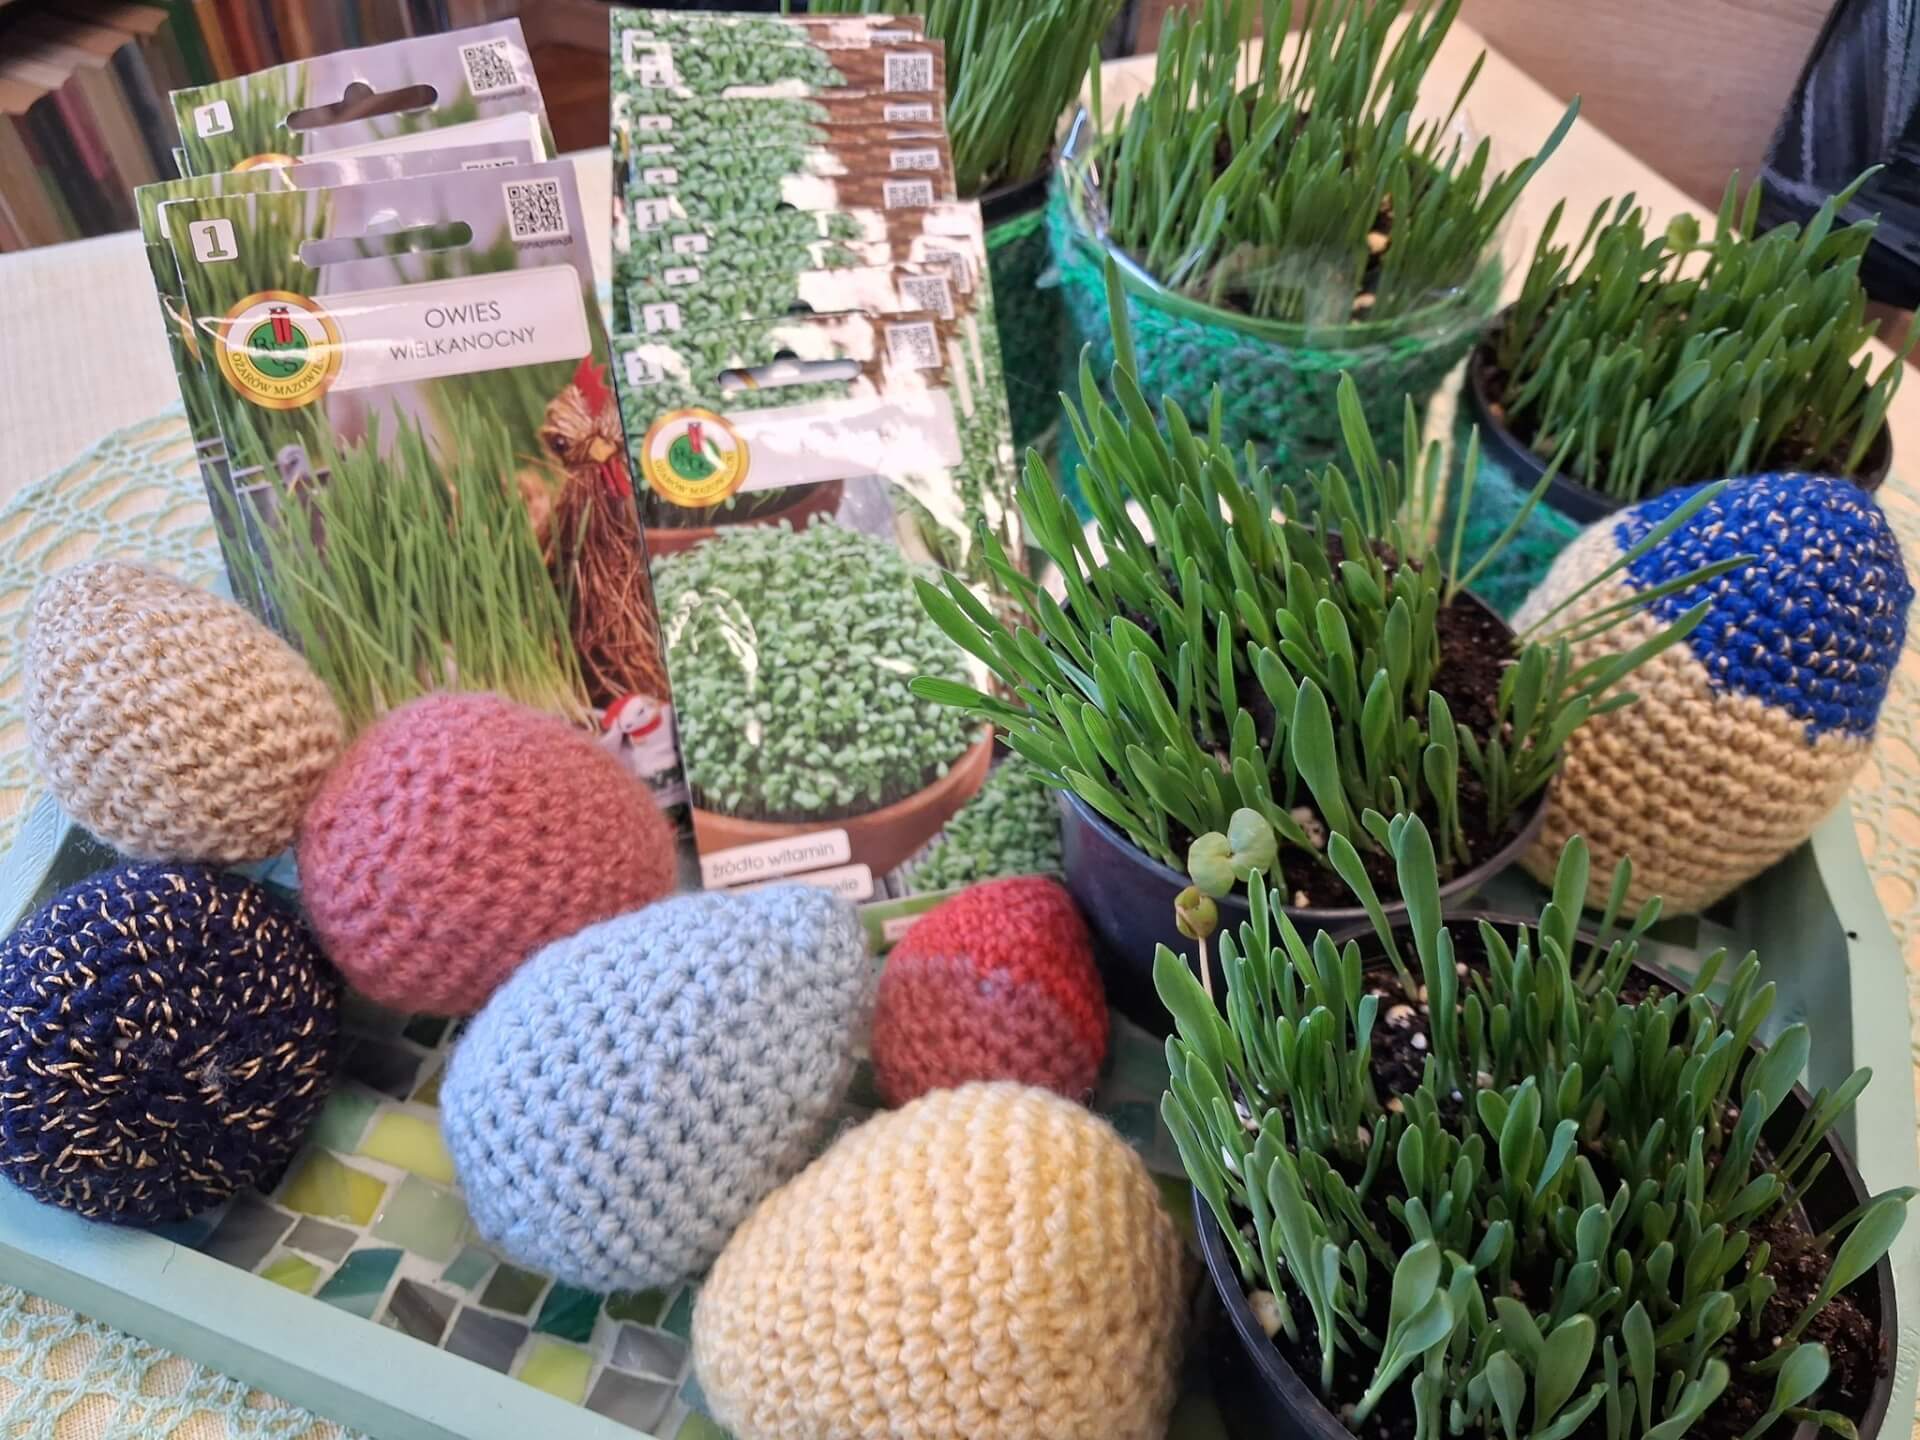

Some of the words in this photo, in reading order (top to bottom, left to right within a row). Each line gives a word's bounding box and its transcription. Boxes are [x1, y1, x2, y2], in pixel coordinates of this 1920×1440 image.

[204, 108, 225, 133] 1
[202, 225, 228, 258] 1
[425, 300, 501, 329] OWIES
[390, 325, 536, 361] WIELKANOCNY
[768, 842, 835, 867] witamin
